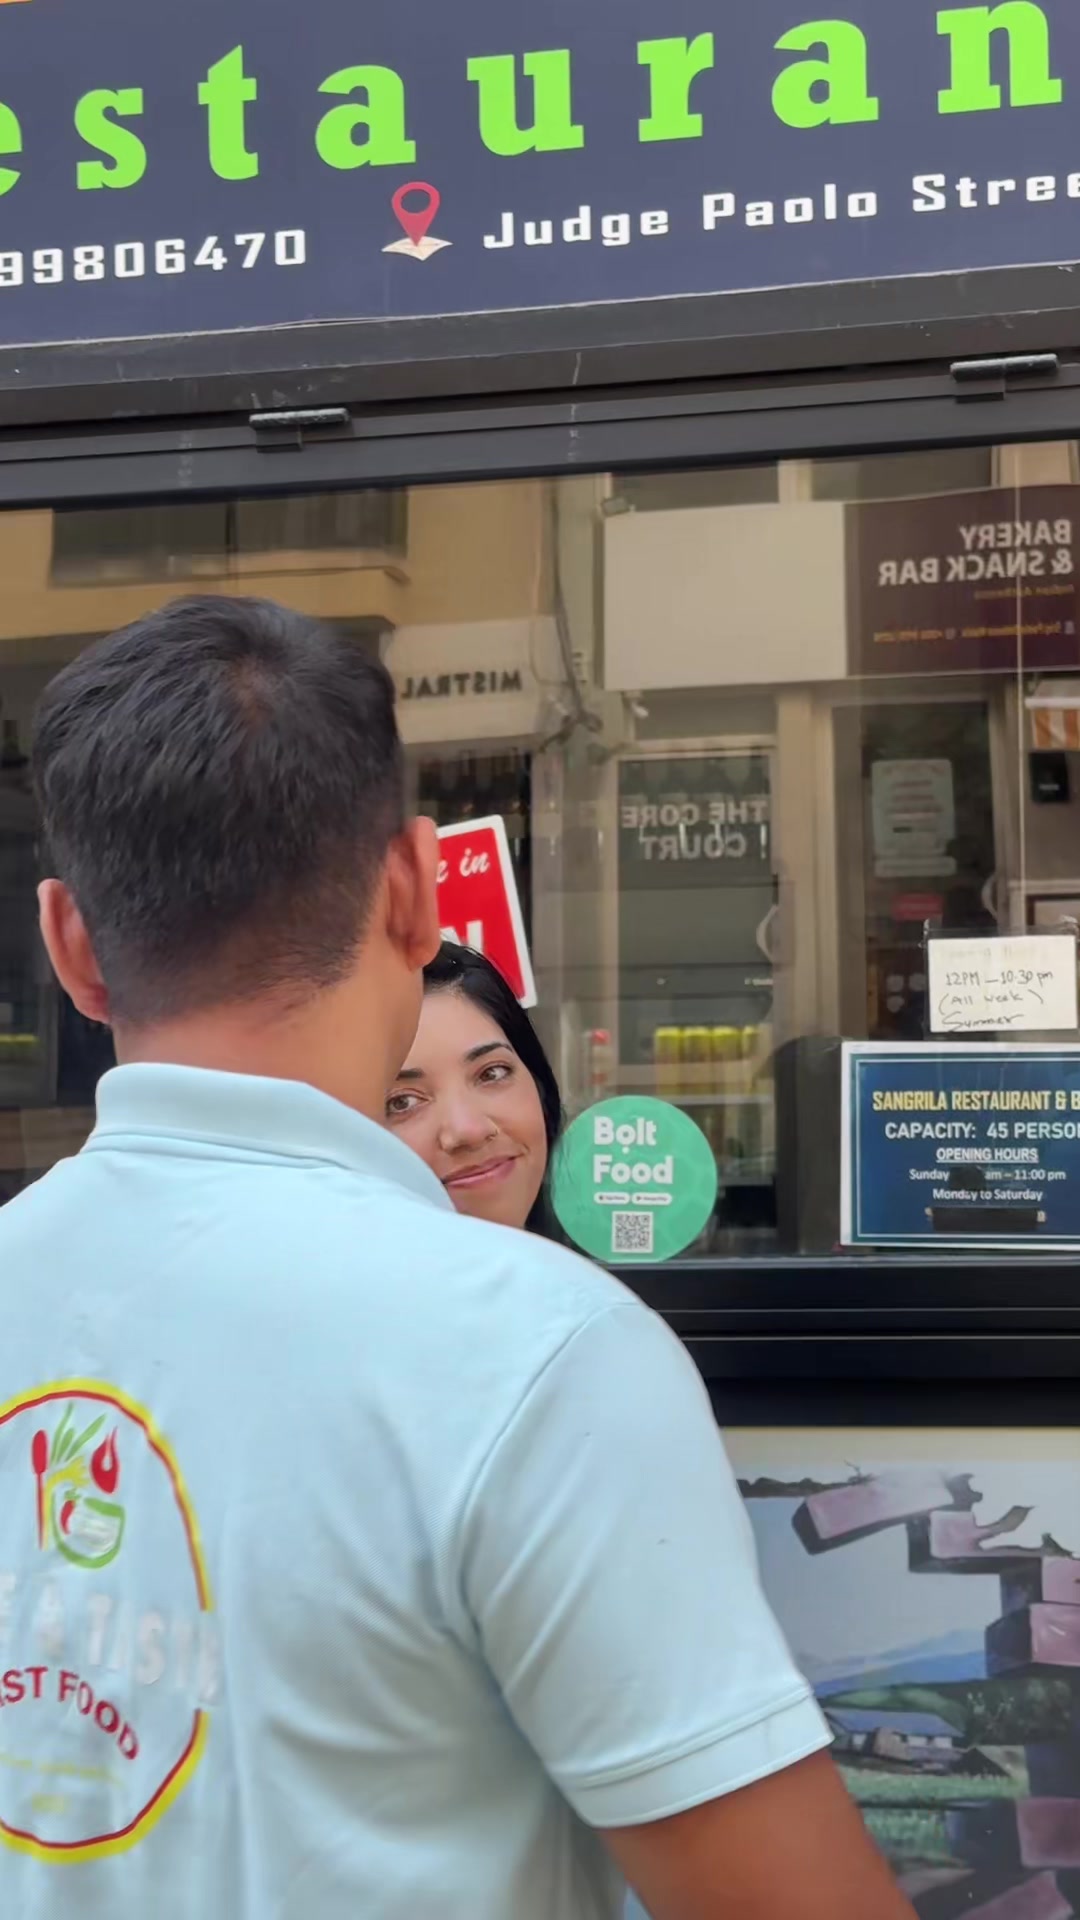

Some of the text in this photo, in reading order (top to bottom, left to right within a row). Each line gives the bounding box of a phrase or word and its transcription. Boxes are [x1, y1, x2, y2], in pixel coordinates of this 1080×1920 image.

[484, 205, 668, 248] Judge
[703, 184, 877, 230] Paolo
[0, 229, 306, 287] 99806470
[459, 848, 490, 877] in
[942, 1011, 1024, 1032] Summer
[872, 1091, 947, 1110] SANGRILA
[952, 1091, 1051, 1110] RESTAURANT
[1055, 1091, 1067, 1110] &
[594, 1116, 657, 1147] Bolt
[885, 1122, 1080, 1139] CAPACITY: 45 PERSO
[936, 1148, 1039, 1162] OPENING HOURS
[593, 1154, 674, 1184] Food
[909, 1168, 950, 1181] Sunday
[1014, 1168, 1045, 1180] 11:00
[1047, 1171, 1066, 1182] pm
[933, 1188, 1043, 1201] Monday to Saturday
[0, 1666, 140, 1760] ST FOOD
